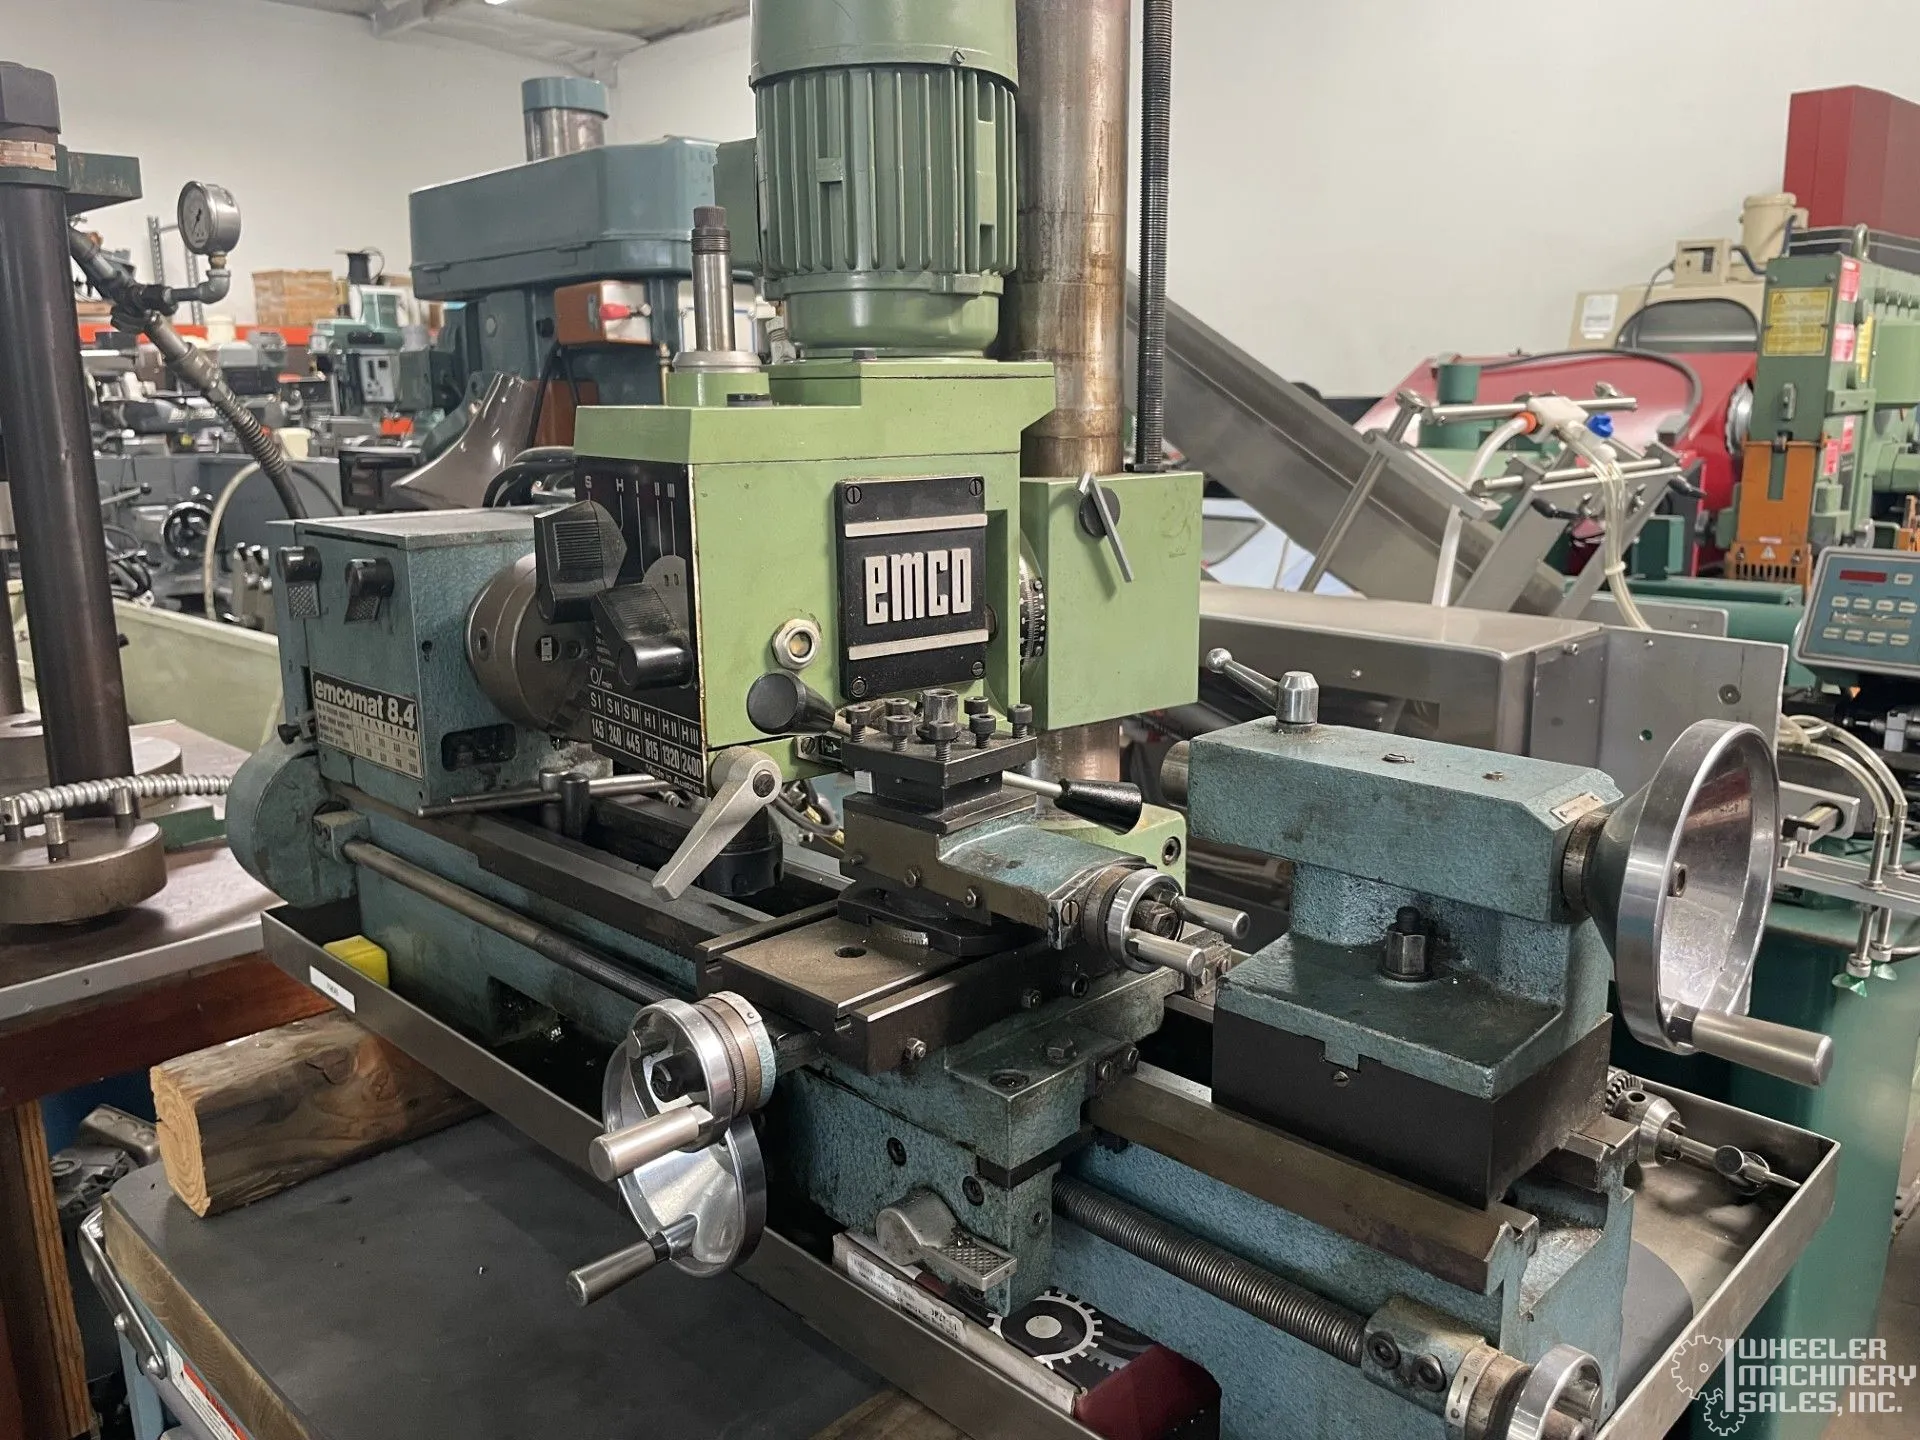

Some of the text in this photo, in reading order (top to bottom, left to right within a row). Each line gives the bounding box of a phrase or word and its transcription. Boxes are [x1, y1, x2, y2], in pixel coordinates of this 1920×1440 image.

[585, 476, 592, 488] S
[616, 478, 624, 492] H
[865, 548, 972, 625] emco
[315, 680, 384, 719] emcomat
[388, 698, 415, 729] 8.4
[592, 718, 605, 738] 145
[609, 725, 622, 745] 240
[626, 732, 641, 753] 445
[663, 745, 679, 769] 1320
[682, 753, 701, 778] 2400
